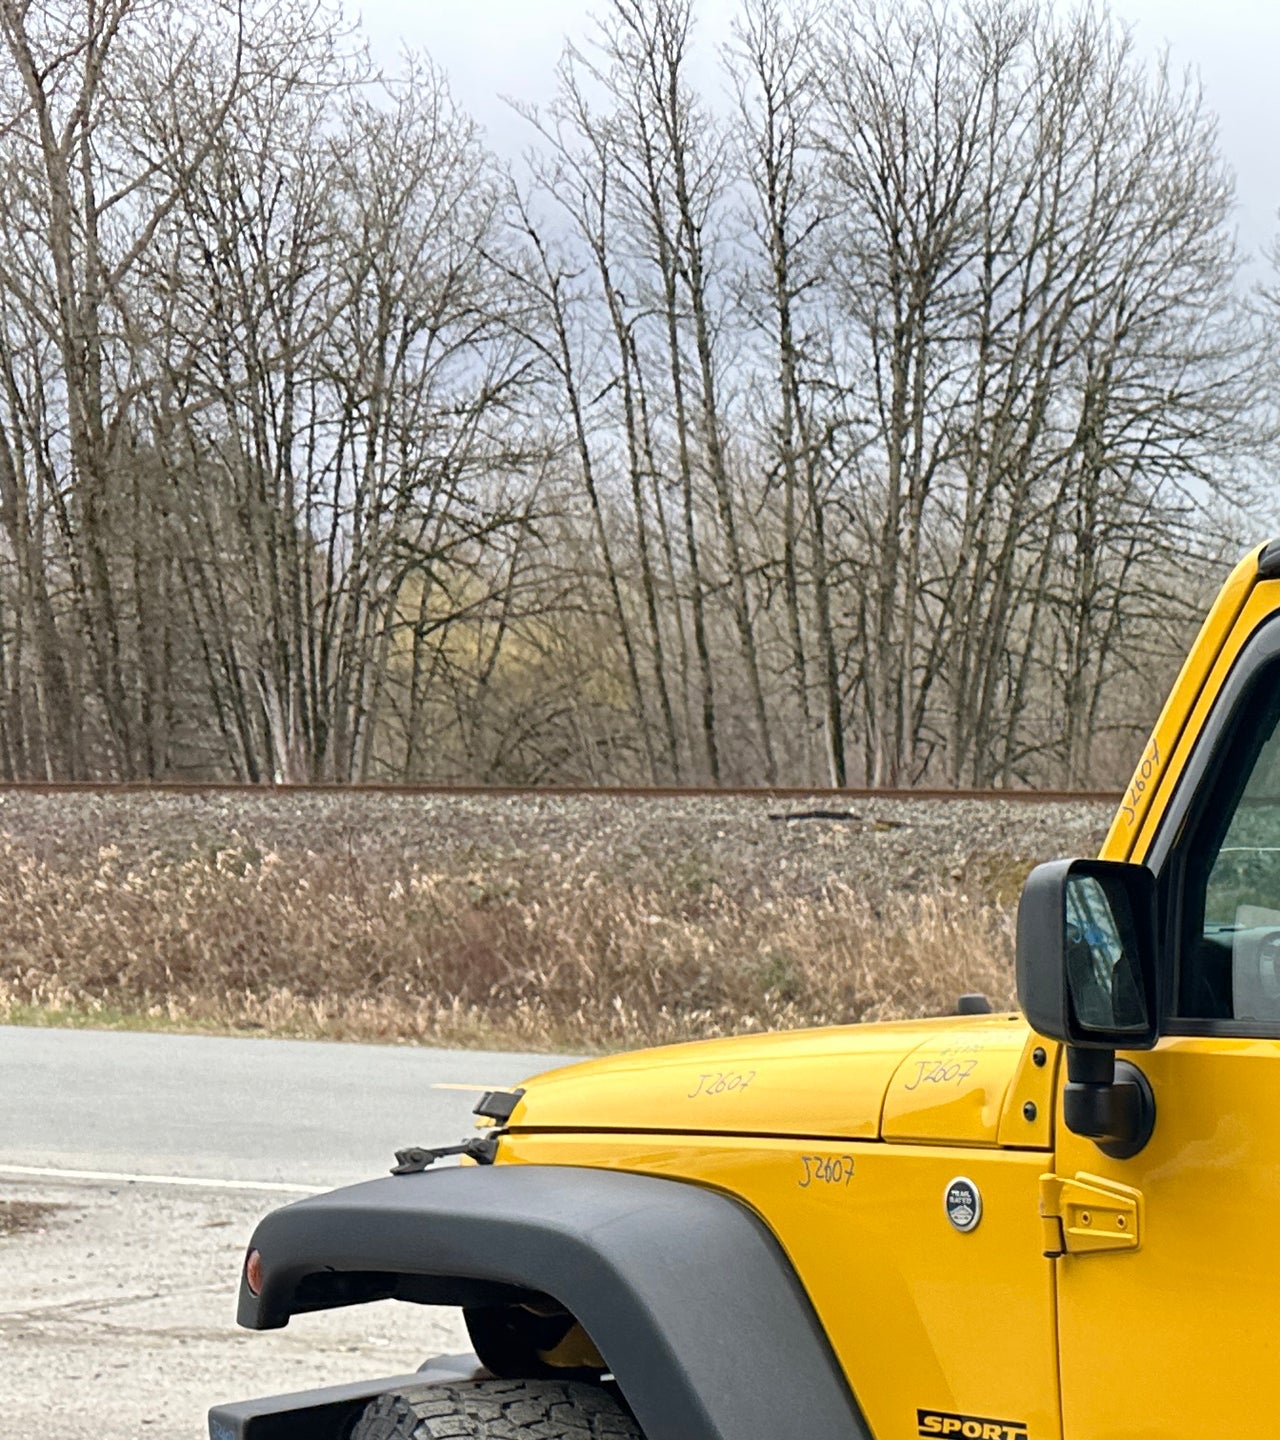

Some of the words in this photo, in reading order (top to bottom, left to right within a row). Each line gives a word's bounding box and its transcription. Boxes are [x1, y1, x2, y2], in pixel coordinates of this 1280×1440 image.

[1122, 738, 1160, 826] J2607
[687, 1070, 757, 1098] J2607
[904, 1060, 978, 1090] J2607
[798, 1156, 855, 1188] J2607
